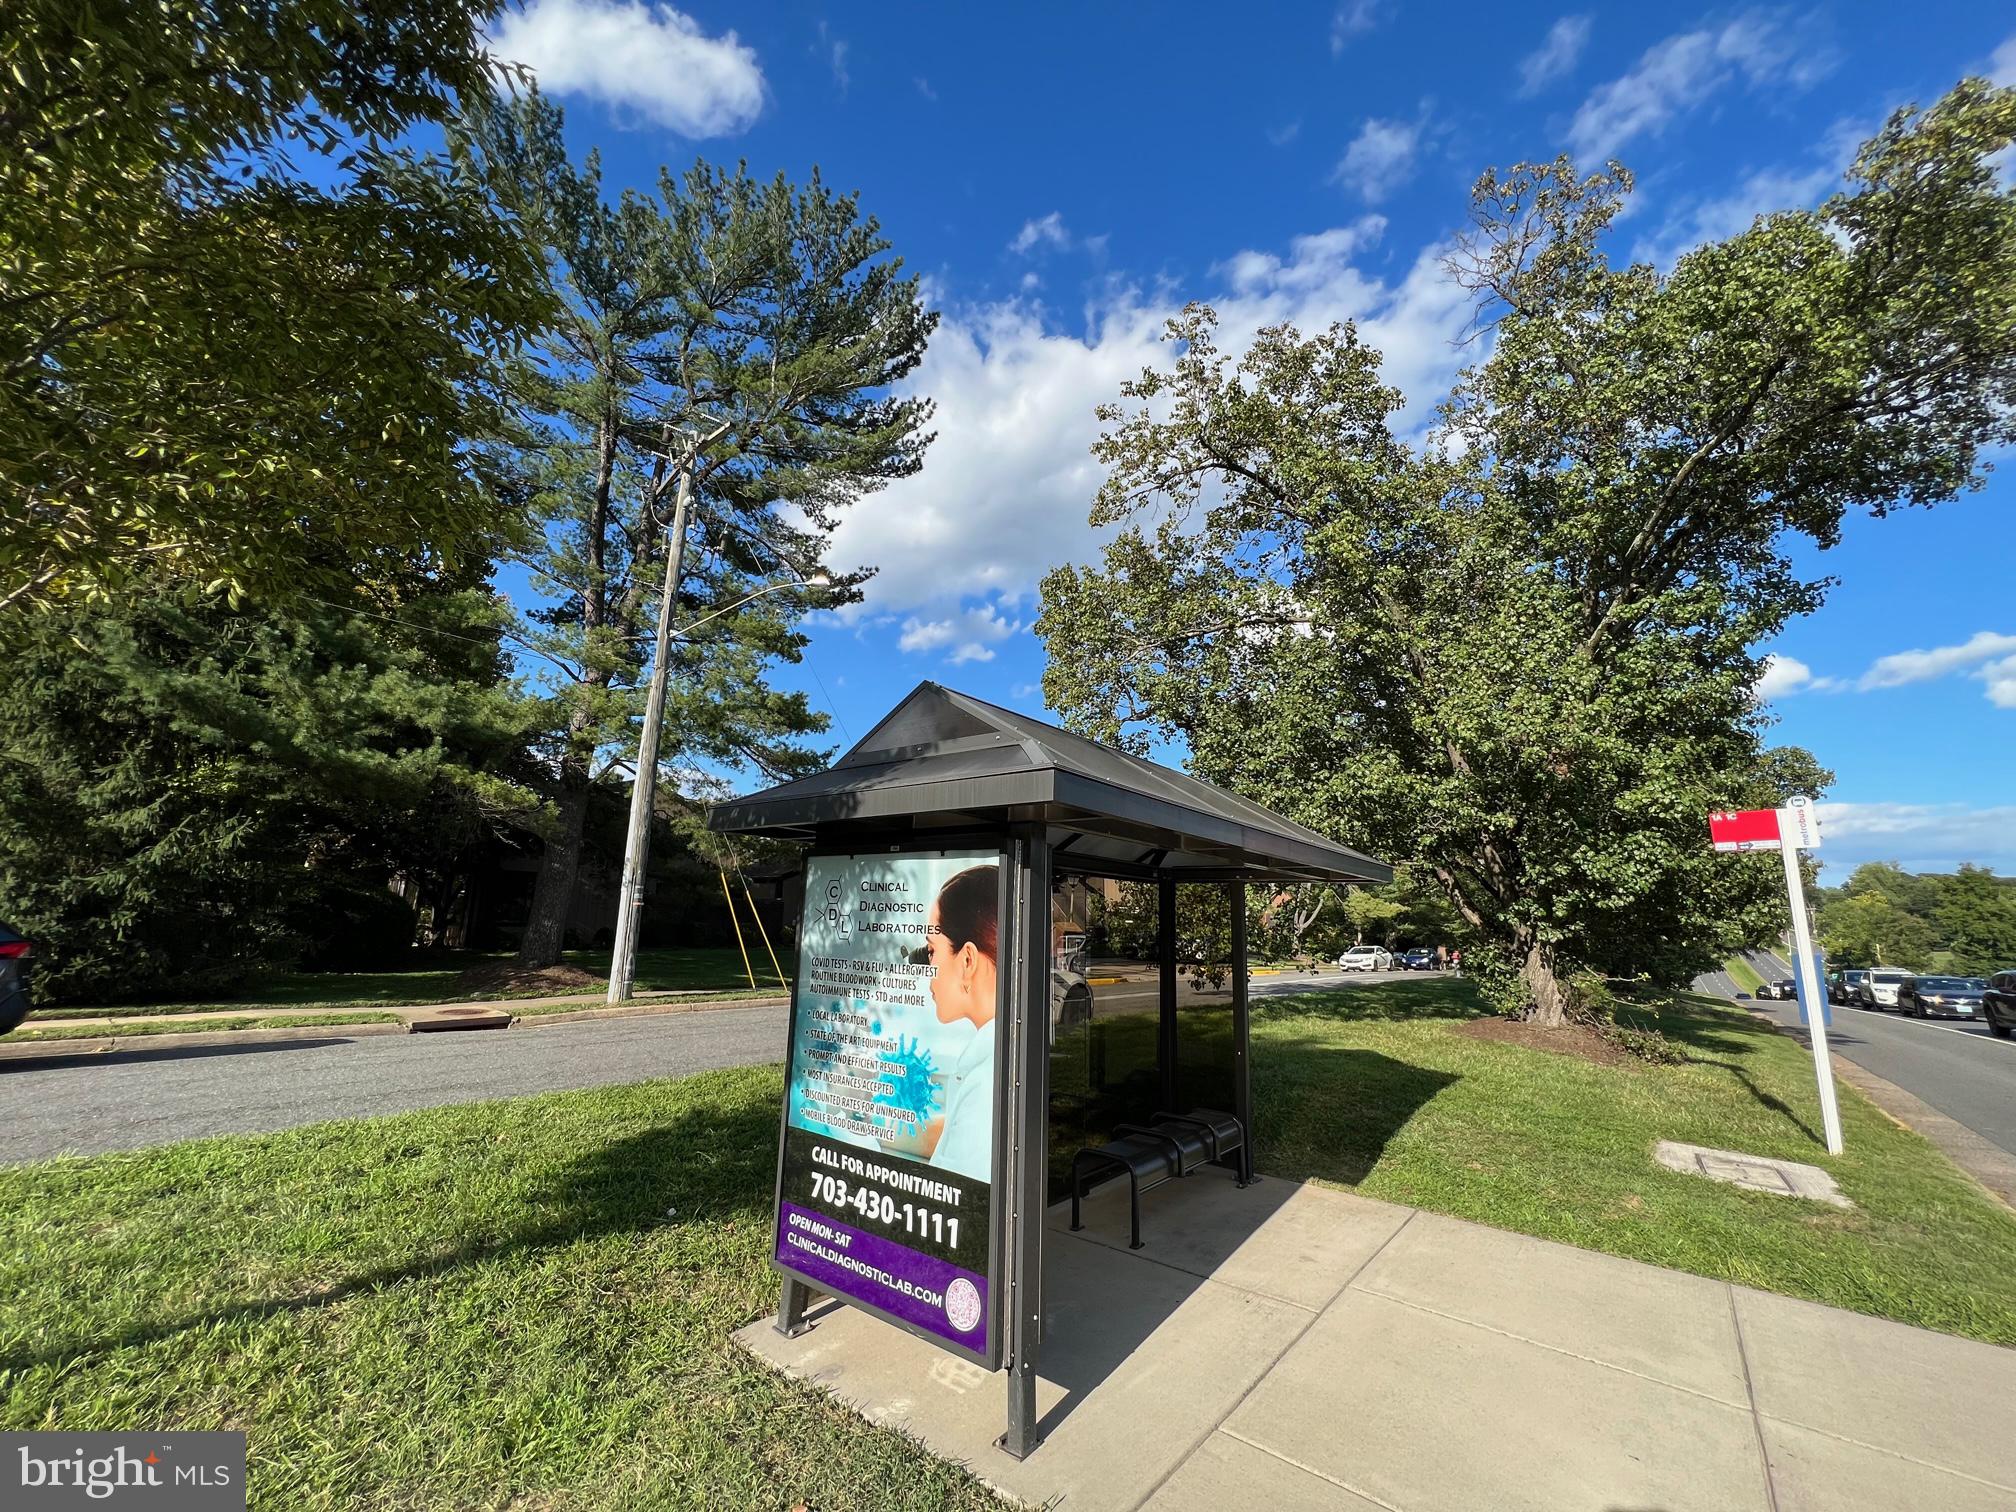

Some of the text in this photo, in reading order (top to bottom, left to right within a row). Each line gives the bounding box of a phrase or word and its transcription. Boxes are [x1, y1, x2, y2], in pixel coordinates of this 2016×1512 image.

[1797, 808, 1810, 846] metrobus
[830, 886, 838, 898] C
[861, 882, 908, 892] CLINICAL
[829, 909, 838, 921] D
[859, 901, 924, 913] DIAGNOSTIC
[841, 921, 848, 933] L
[858, 921, 941, 935] LABORATORIES
[811, 956, 938, 977] COVID TESTS RSV & FLU ALLERGY TEST
[811, 970, 917, 990] ROUTINE BLOODWORK CULTURES
[810, 984, 925, 1006] AUTOIMMUNE TESTS STD and MORE
[812, 1011, 868, 1027] LOCAL LABORATORY
[810, 1030, 897, 1052] STATE OF THE ART EQUIPMENT
[808, 1049, 906, 1076] PROMPT AND EFFICIENT RESULTS
[807, 1069, 894, 1096] MOST INSURANCES ACCEPTED
[805, 1088, 916, 1123] DISCOUNTED RATES FOR UNINSURED
[805, 1110, 894, 1141] MOBILE BLOOD DRAW SERVICE
[811, 1146, 961, 1206] CALL FOR APPOINTMENT
[811, 1171, 959, 1249] 703-430-1111
[789, 1213, 811, 1233] OPEN
[787, 1231, 942, 1308] CLINICALDIAGNOSTICLAB.COM
